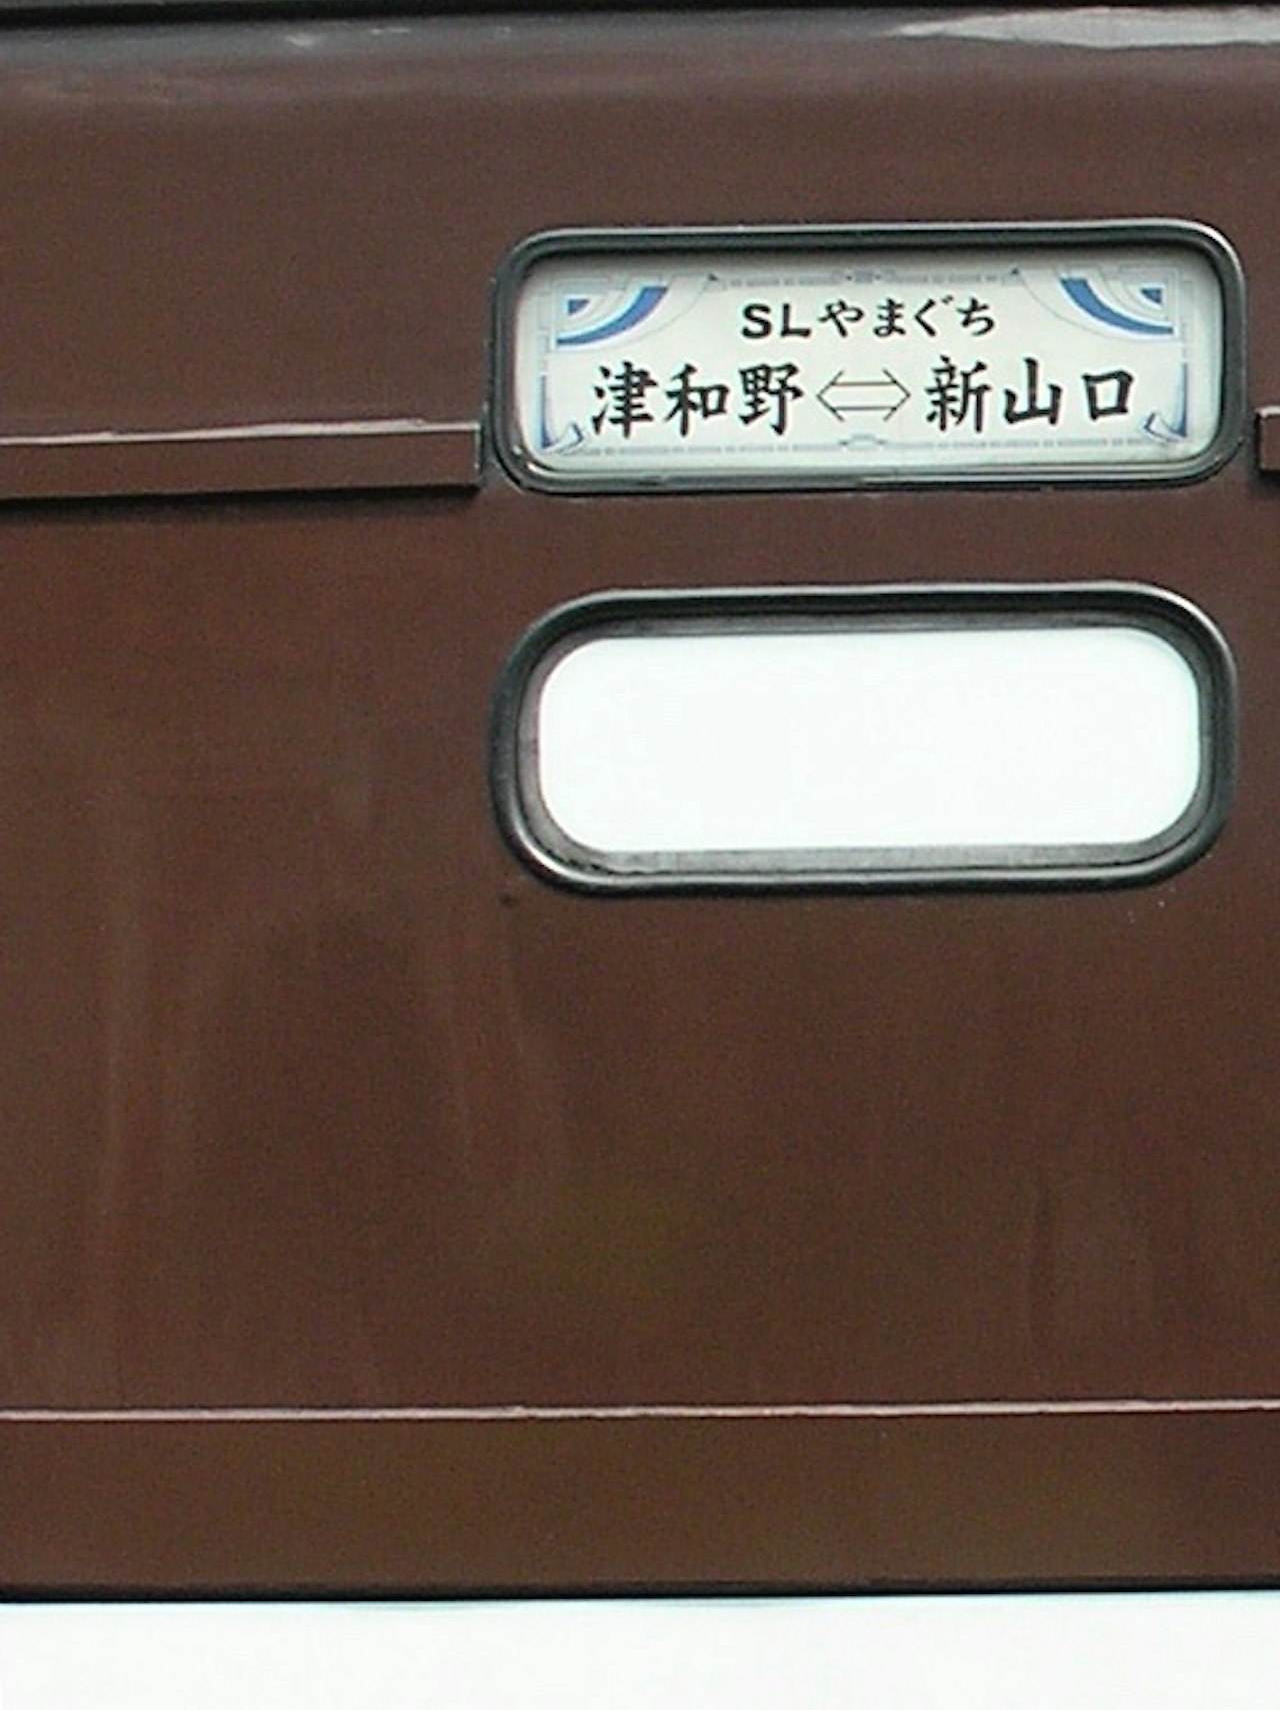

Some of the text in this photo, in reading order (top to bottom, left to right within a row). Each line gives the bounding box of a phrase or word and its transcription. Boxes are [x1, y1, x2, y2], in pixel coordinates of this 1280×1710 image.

[741, 294, 996, 339] SLやまぐち
[591, 355, 1134, 439] 津和野 新山口
